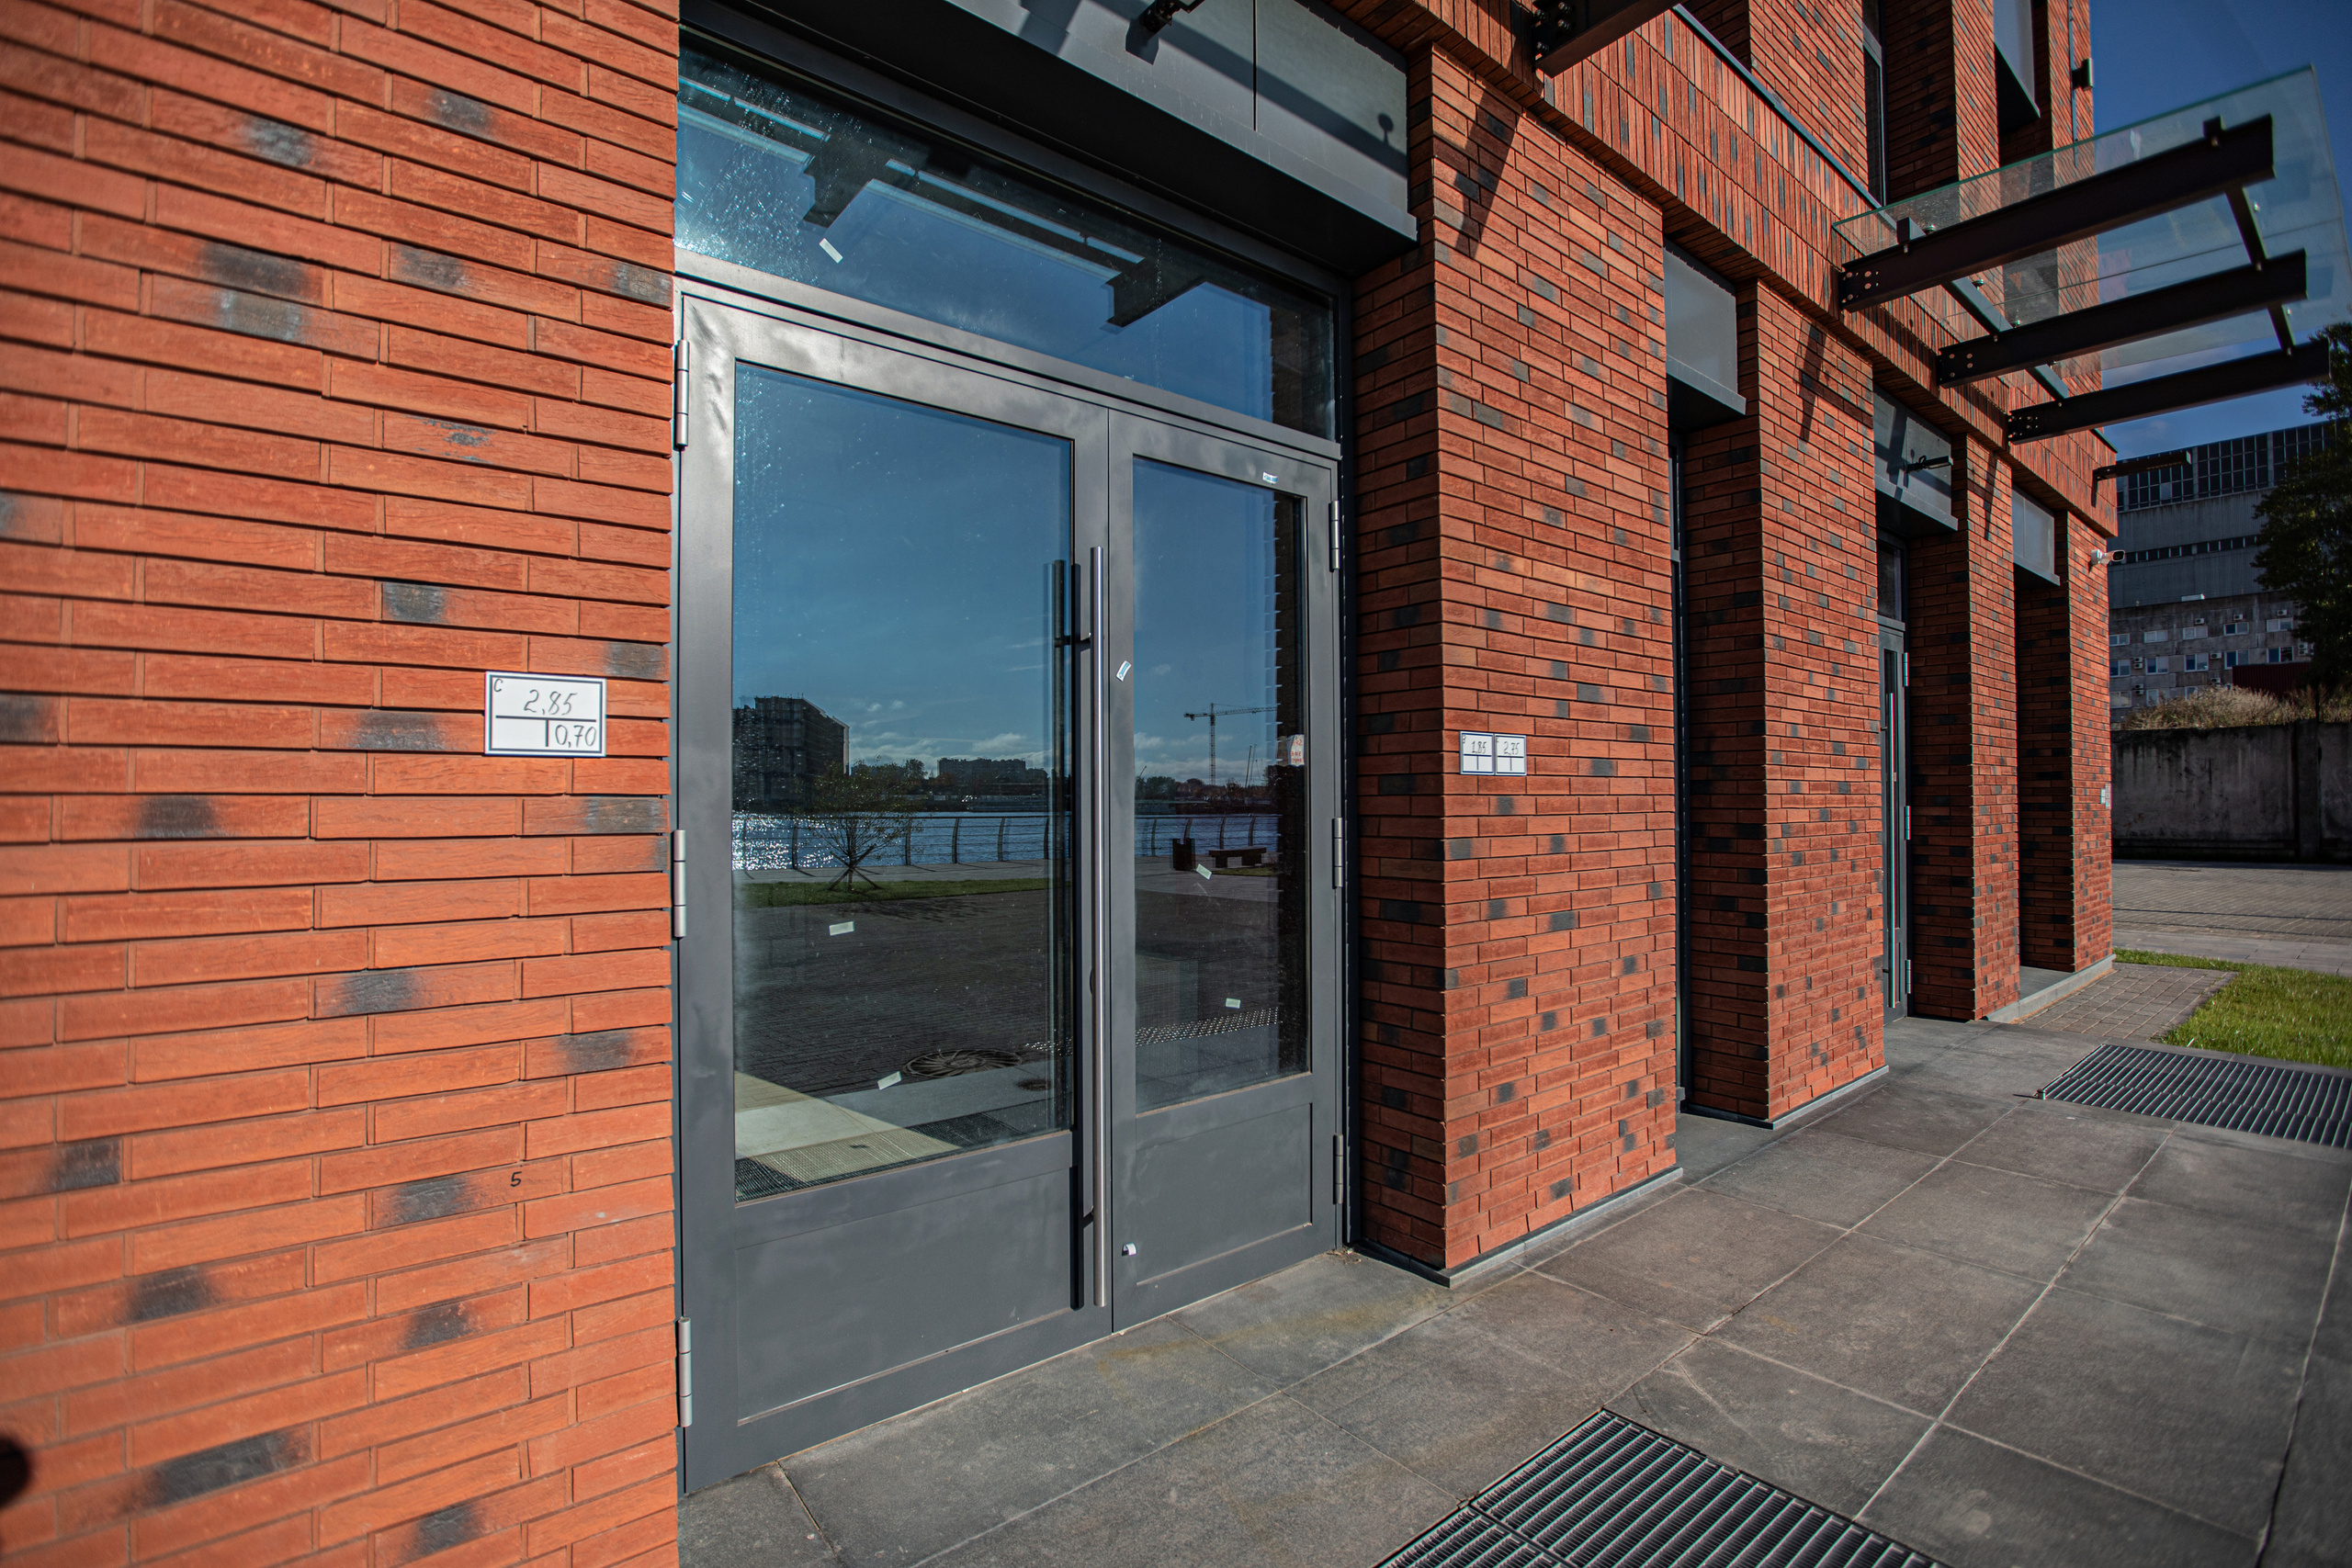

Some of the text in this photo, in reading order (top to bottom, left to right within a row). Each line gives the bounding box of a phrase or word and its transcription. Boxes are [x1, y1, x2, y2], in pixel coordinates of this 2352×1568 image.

[523, 689, 578, 716] 2,85
[554, 724, 597, 749] 0,70
[510, 1171, 523, 1188] 5
